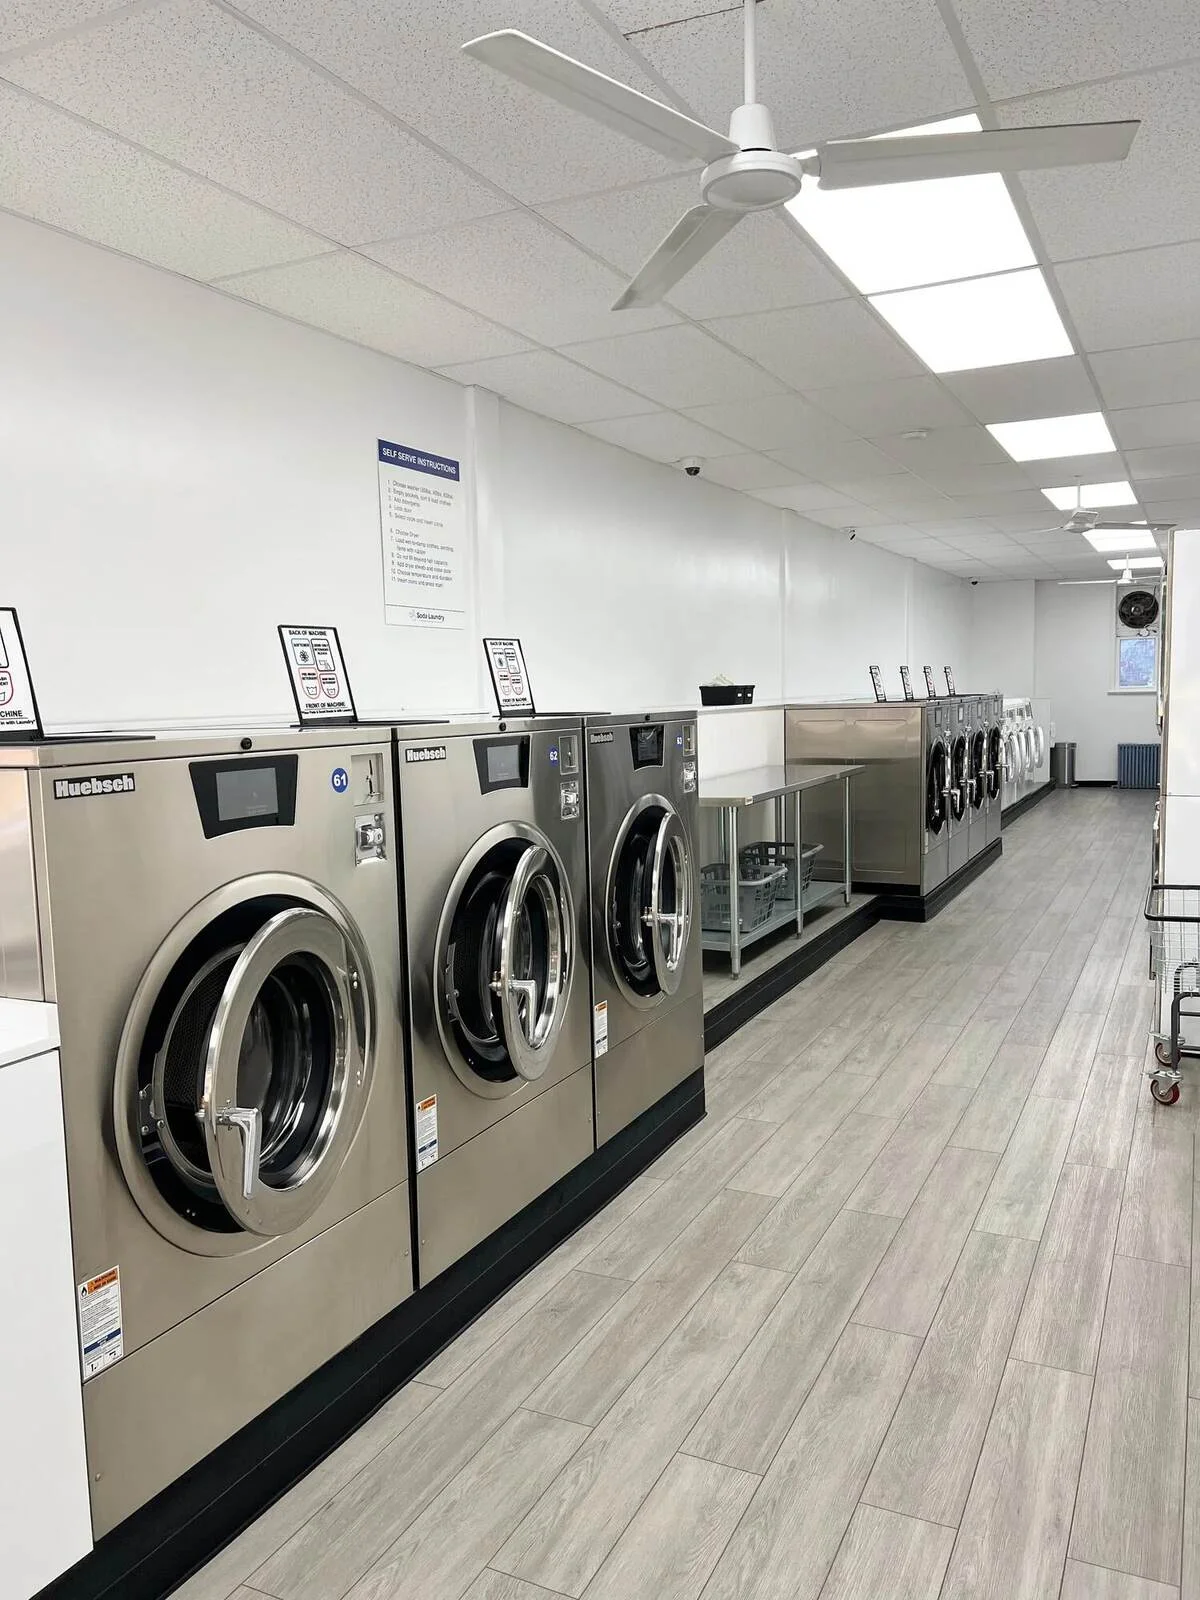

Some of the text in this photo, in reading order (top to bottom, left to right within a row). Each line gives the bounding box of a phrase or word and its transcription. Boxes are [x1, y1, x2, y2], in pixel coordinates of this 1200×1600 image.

[383, 447, 456, 475] SELF SERVE INSTRUCTIONS
[428, 613, 445, 622] Laundry
[406, 748, 446, 762] Huebsch
[550, 750, 558, 760] 62
[333, 772, 346, 786] 61
[55, 775, 134, 798] Huebsch
